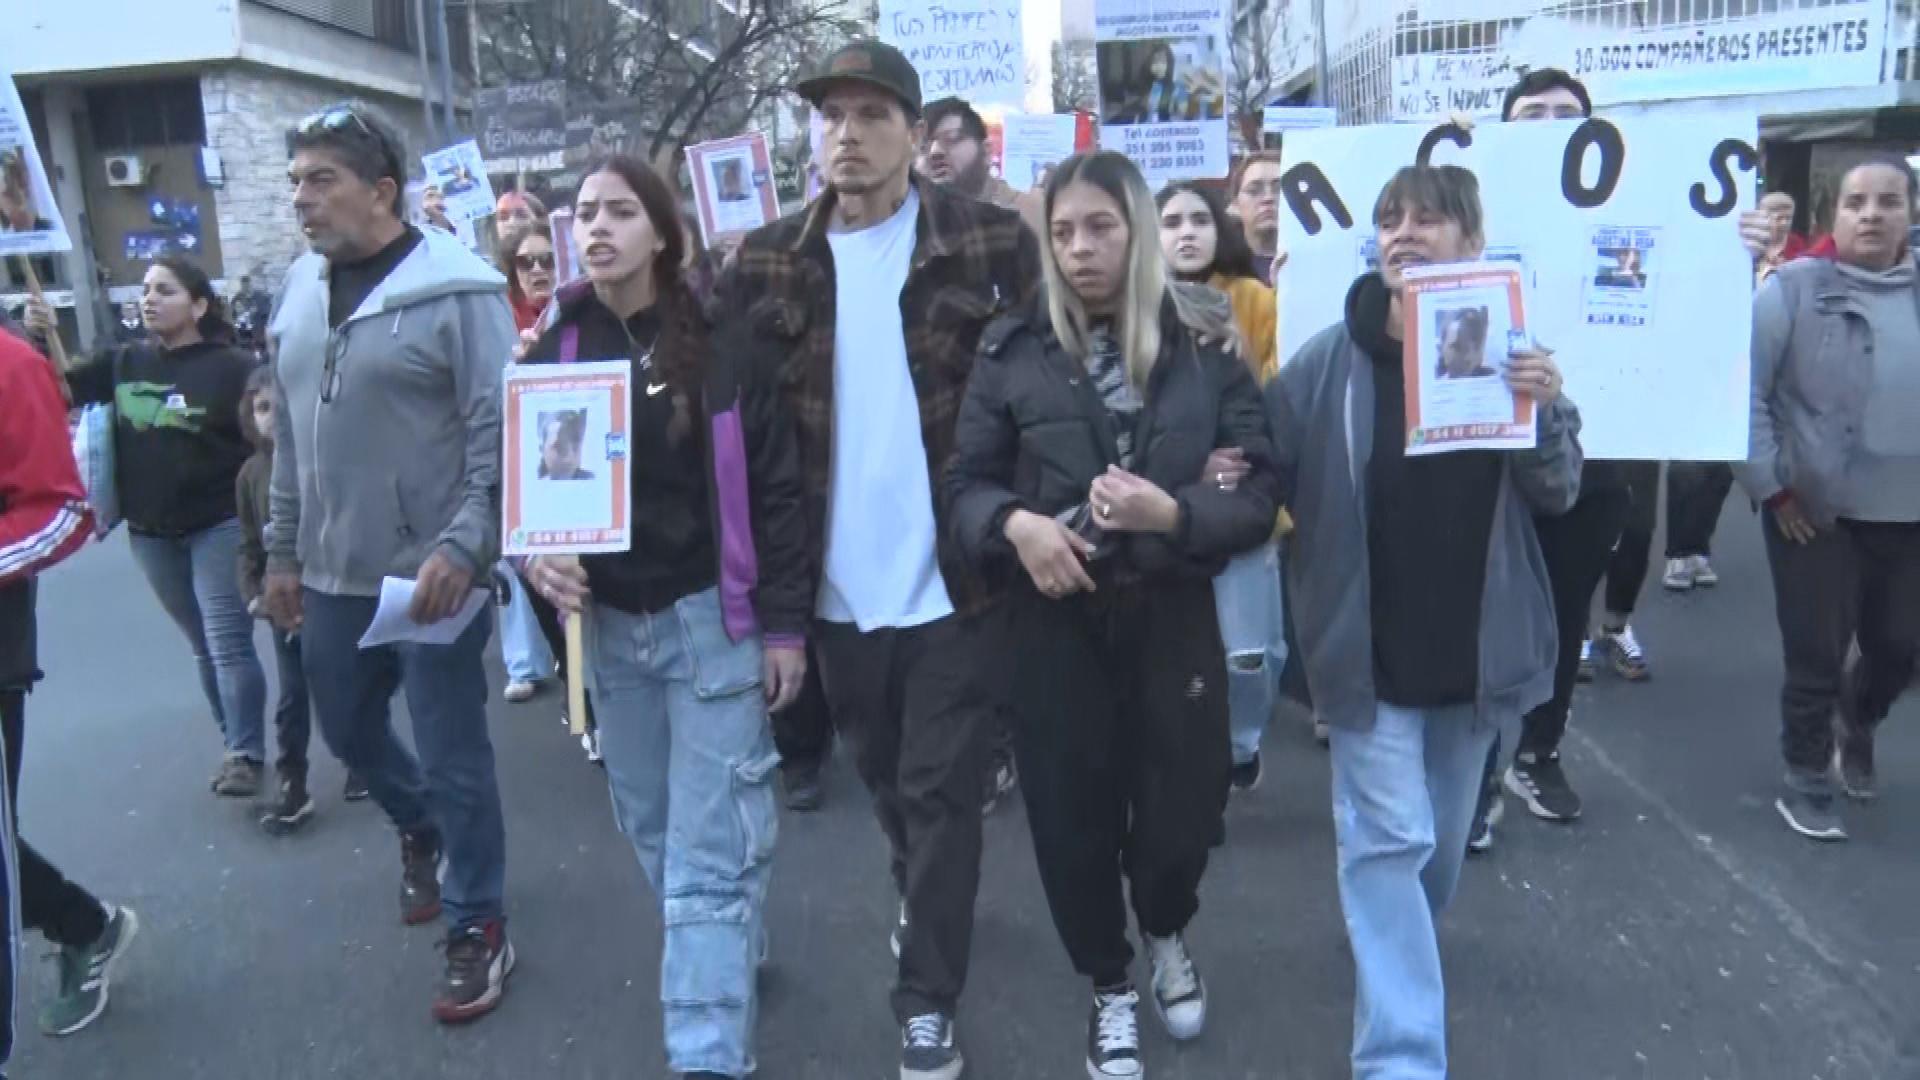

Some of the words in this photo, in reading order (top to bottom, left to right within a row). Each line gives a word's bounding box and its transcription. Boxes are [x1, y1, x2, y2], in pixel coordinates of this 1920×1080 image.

[1575, 45, 1632, 75] 30.000
[1634, 29, 1751, 70] COMPAÑEROS
[1757, 18, 1868, 59] PRESENTES
[1400, 92, 1420, 114] NO
[1424, 89, 1440, 113] SE
[1447, 86, 1506, 113] INDULT
